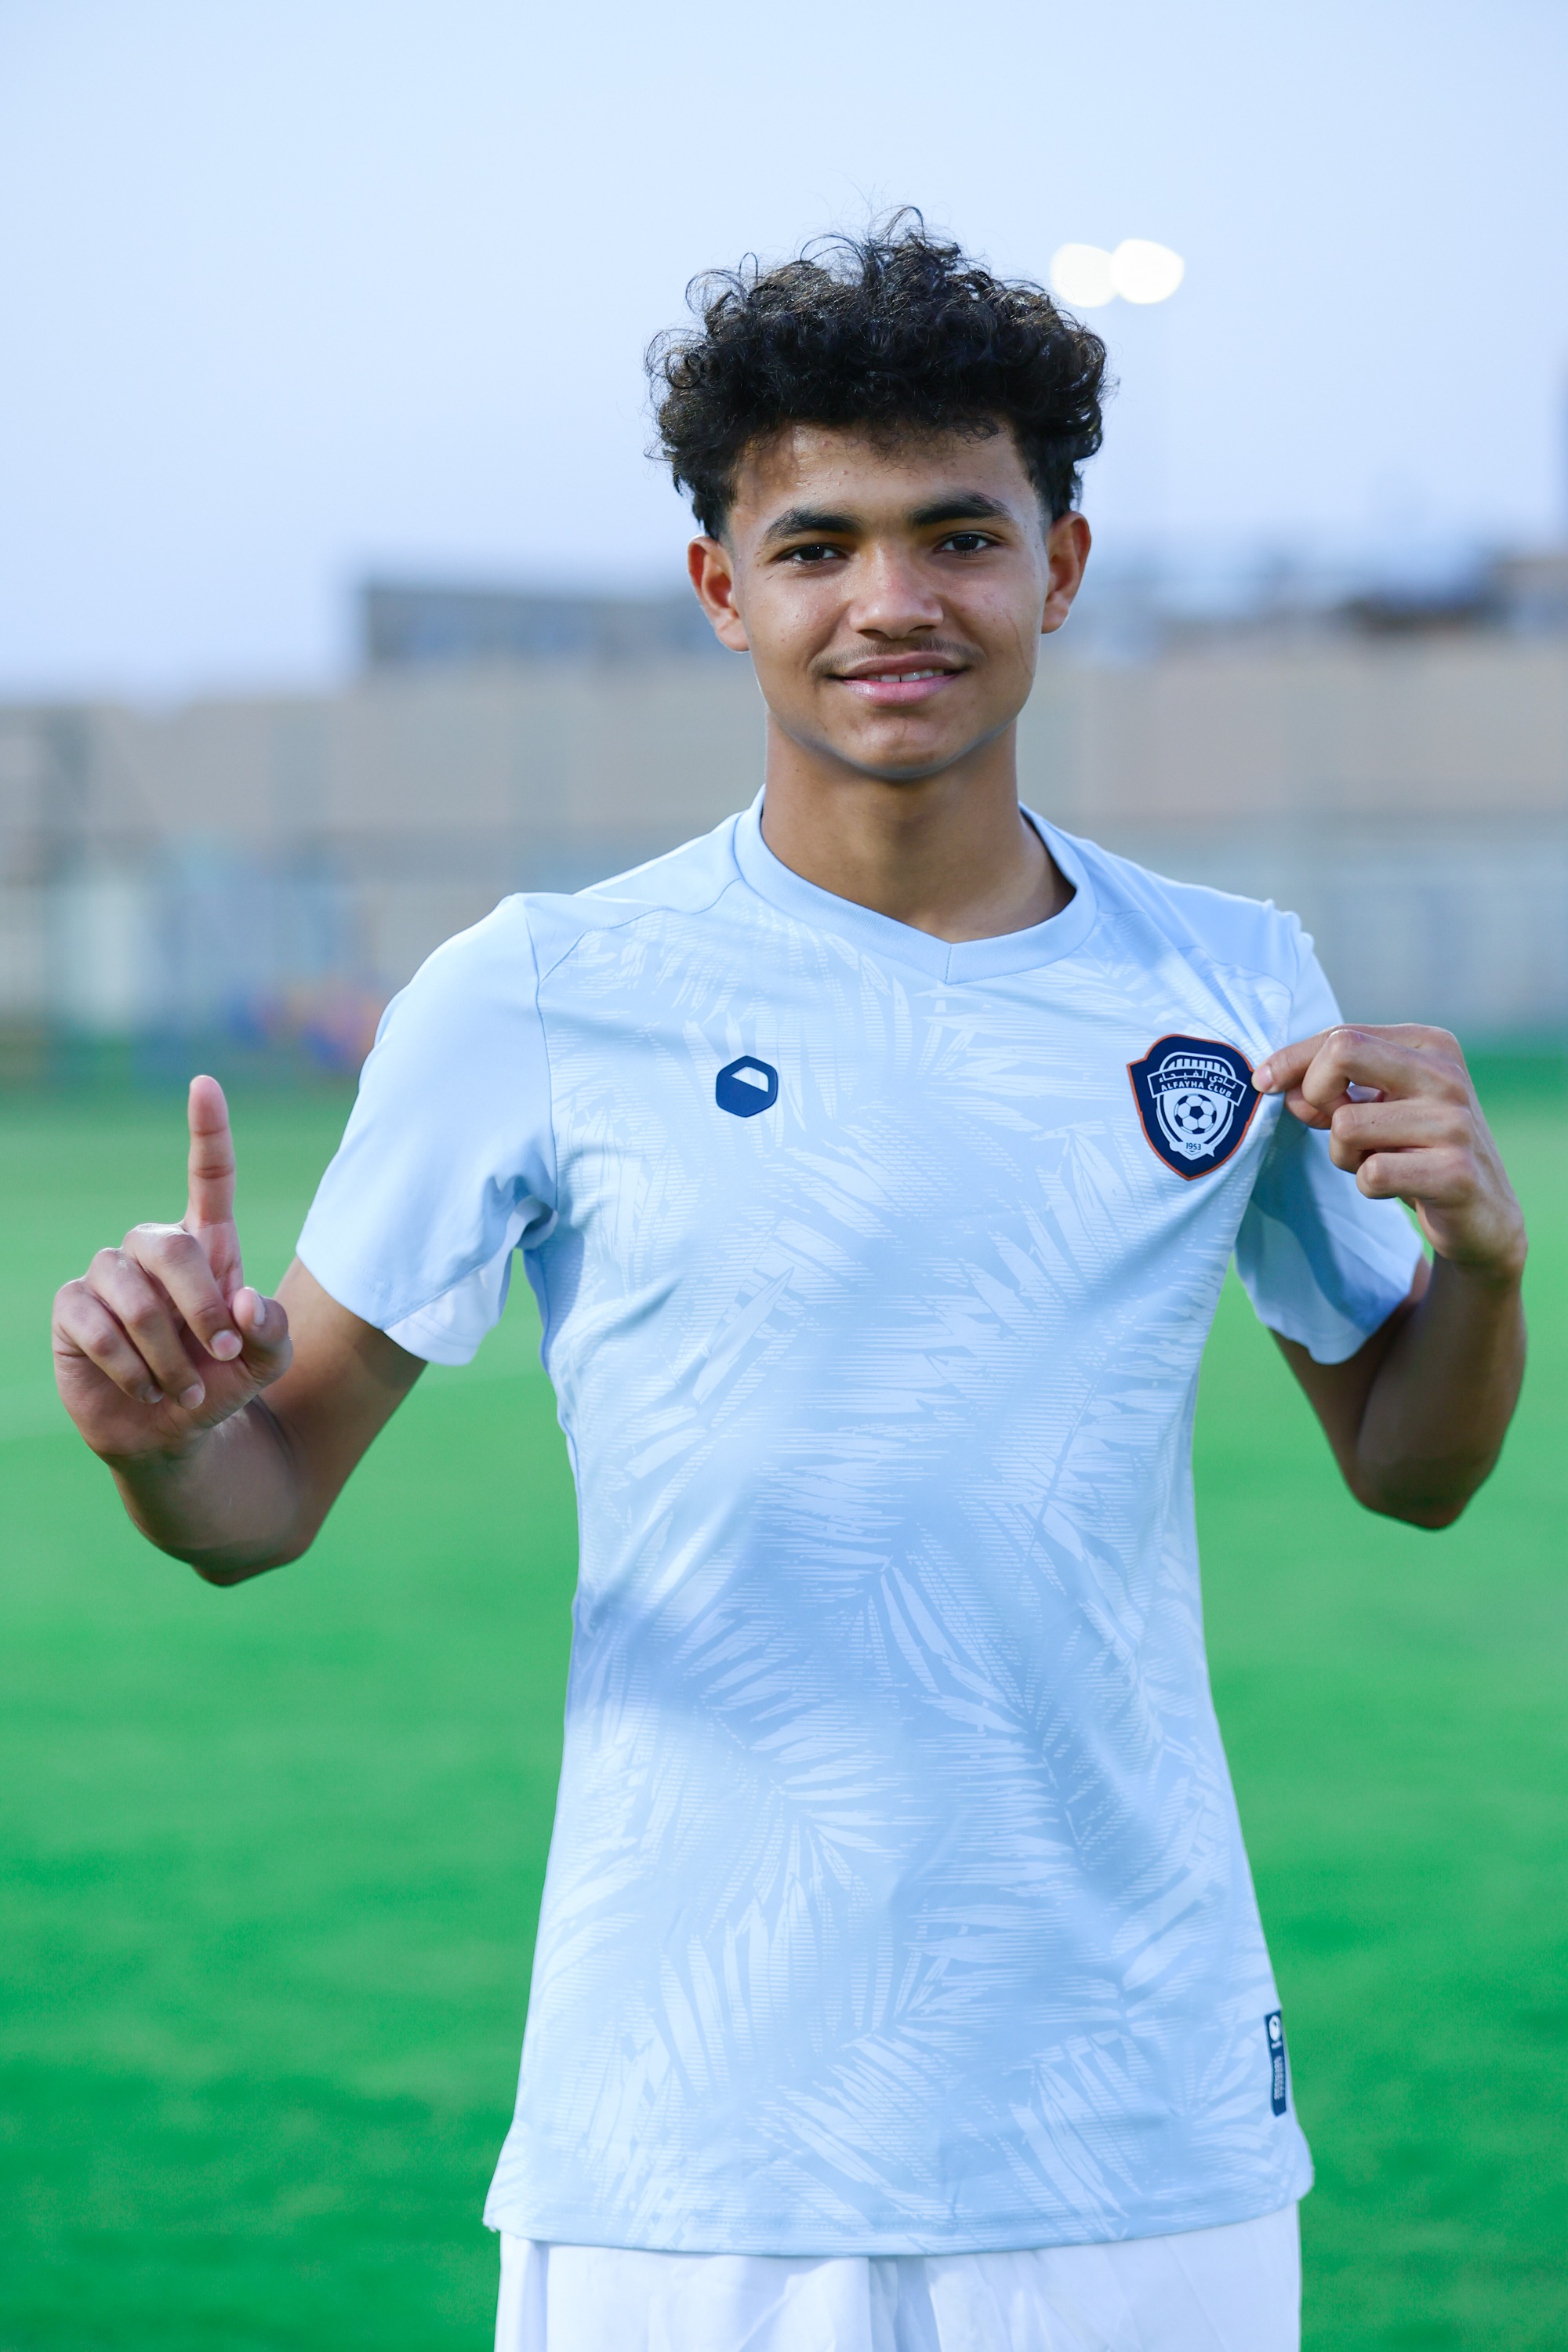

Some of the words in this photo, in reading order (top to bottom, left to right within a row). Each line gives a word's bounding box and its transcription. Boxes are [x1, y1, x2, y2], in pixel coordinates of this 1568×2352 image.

[1159, 1069, 1207, 1083] الفيحاء
[1209, 1075, 1237, 1090] نادي
[1161, 1080, 1204, 1092] ALFAYHA
[1207, 1083, 1232, 1098] CLUB
[1185, 1142, 1201, 1151] 1953
